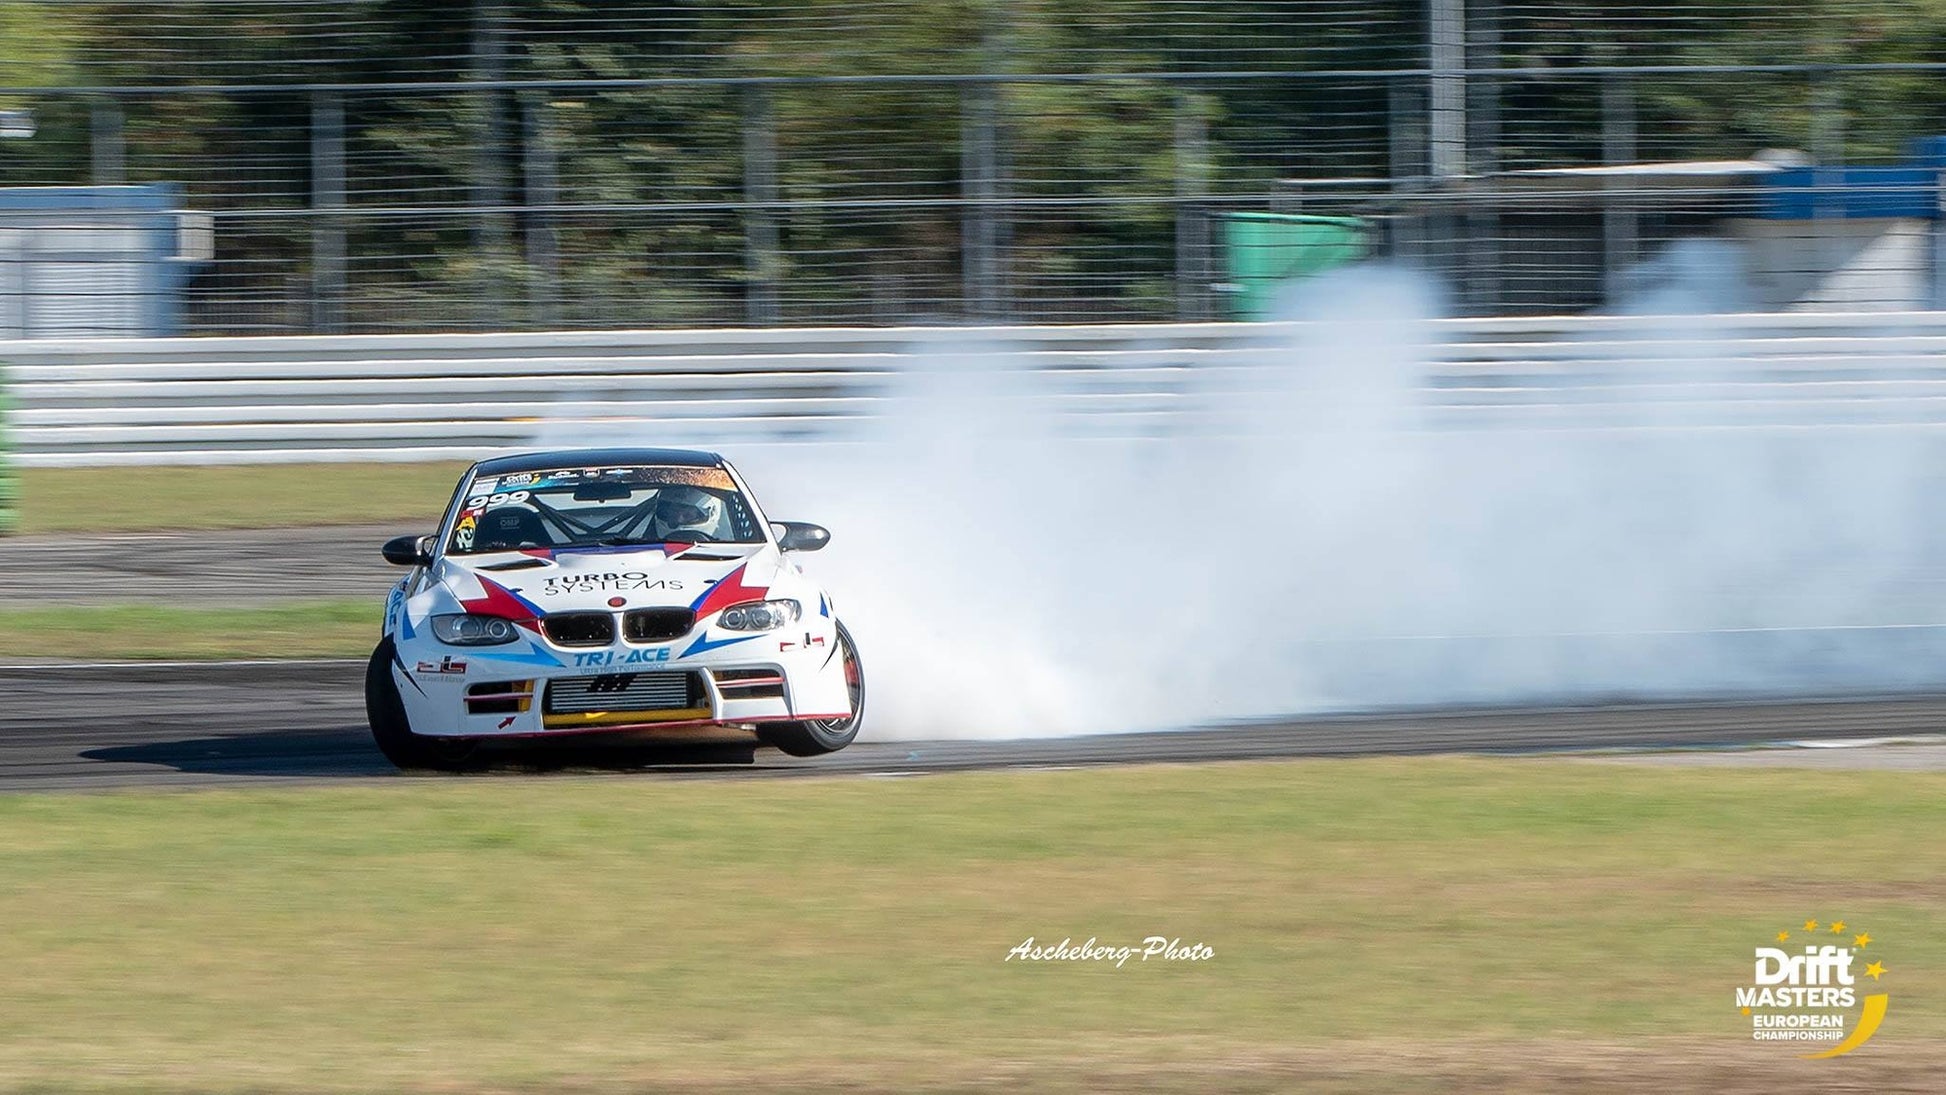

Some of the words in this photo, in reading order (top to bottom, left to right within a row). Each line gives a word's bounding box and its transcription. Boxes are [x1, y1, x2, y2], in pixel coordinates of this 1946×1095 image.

[466, 491, 530, 511] 999
[543, 571, 648, 586] TURBO
[544, 580, 683, 595] SYSTEMS
